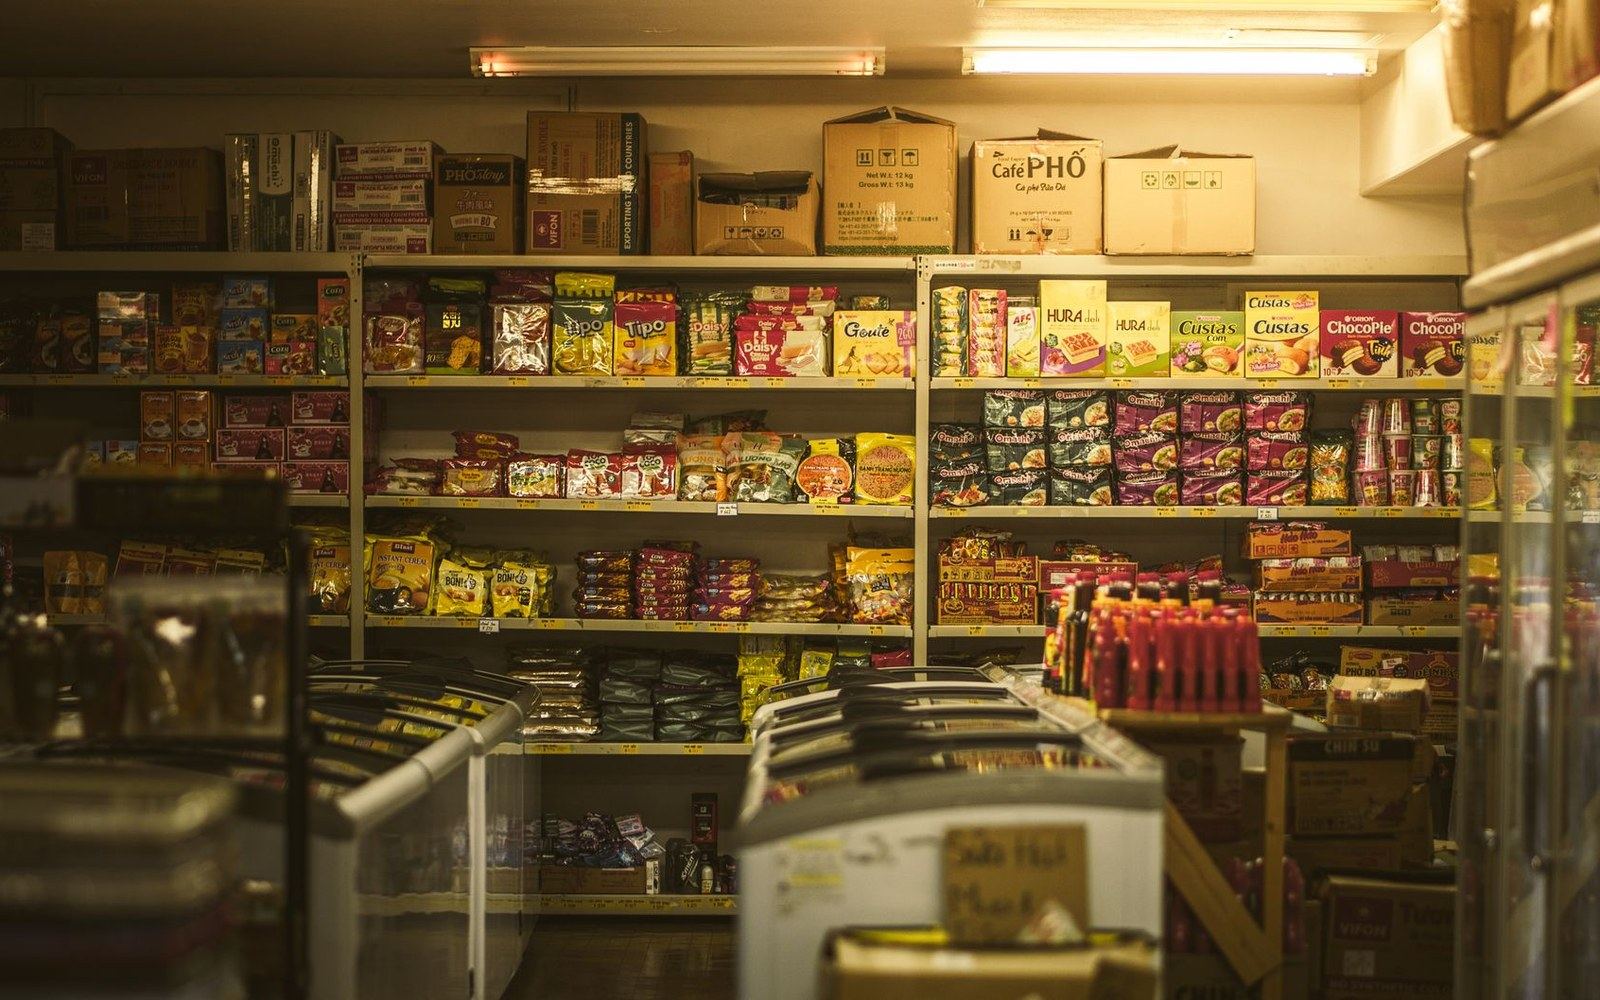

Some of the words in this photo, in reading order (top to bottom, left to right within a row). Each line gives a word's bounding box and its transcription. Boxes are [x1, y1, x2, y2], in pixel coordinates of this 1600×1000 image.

[992, 162, 1025, 179] Café
[1027, 148, 1087, 179] PHỐ
[904, 172, 914, 180] kg
[904, 181, 914, 189] kg
[549, 214, 560, 245] VIFON
[624, 200, 633, 250] EXPORTING
[768, 304, 787, 312] Daisy
[1249, 296, 1291, 309] Custas
[1013, 313, 1031, 325] AFC
[1047, 309, 1083, 323] HURA
[624, 319, 666, 338] Tipo
[693, 321, 728, 334] Daisy
[758, 320, 776, 328] Daisy
[1116, 319, 1146, 331] HURA
[1179, 320, 1237, 336] Custas
[1254, 319, 1310, 335] Custas
[1326, 320, 1392, 335] ChocoPie
[1409, 321, 1466, 335] ChocoPi
[743, 341, 778, 356] Daisy
[1055, 389, 1092, 400] Omachi
[1193, 392, 1229, 403] Omachi
[1253, 392, 1291, 404] Omachi
[1128, 394, 1165, 408] Omachi
[994, 433, 1031, 444] Omachi
[994, 474, 1032, 486] Omachi
[377, 555, 403, 563] INSTANT
[403, 557, 428, 565] CEREAL
[445, 576, 464, 588] BON!
[497, 573, 514, 583] BON!
[1340, 921, 1388, 936] VIFON
